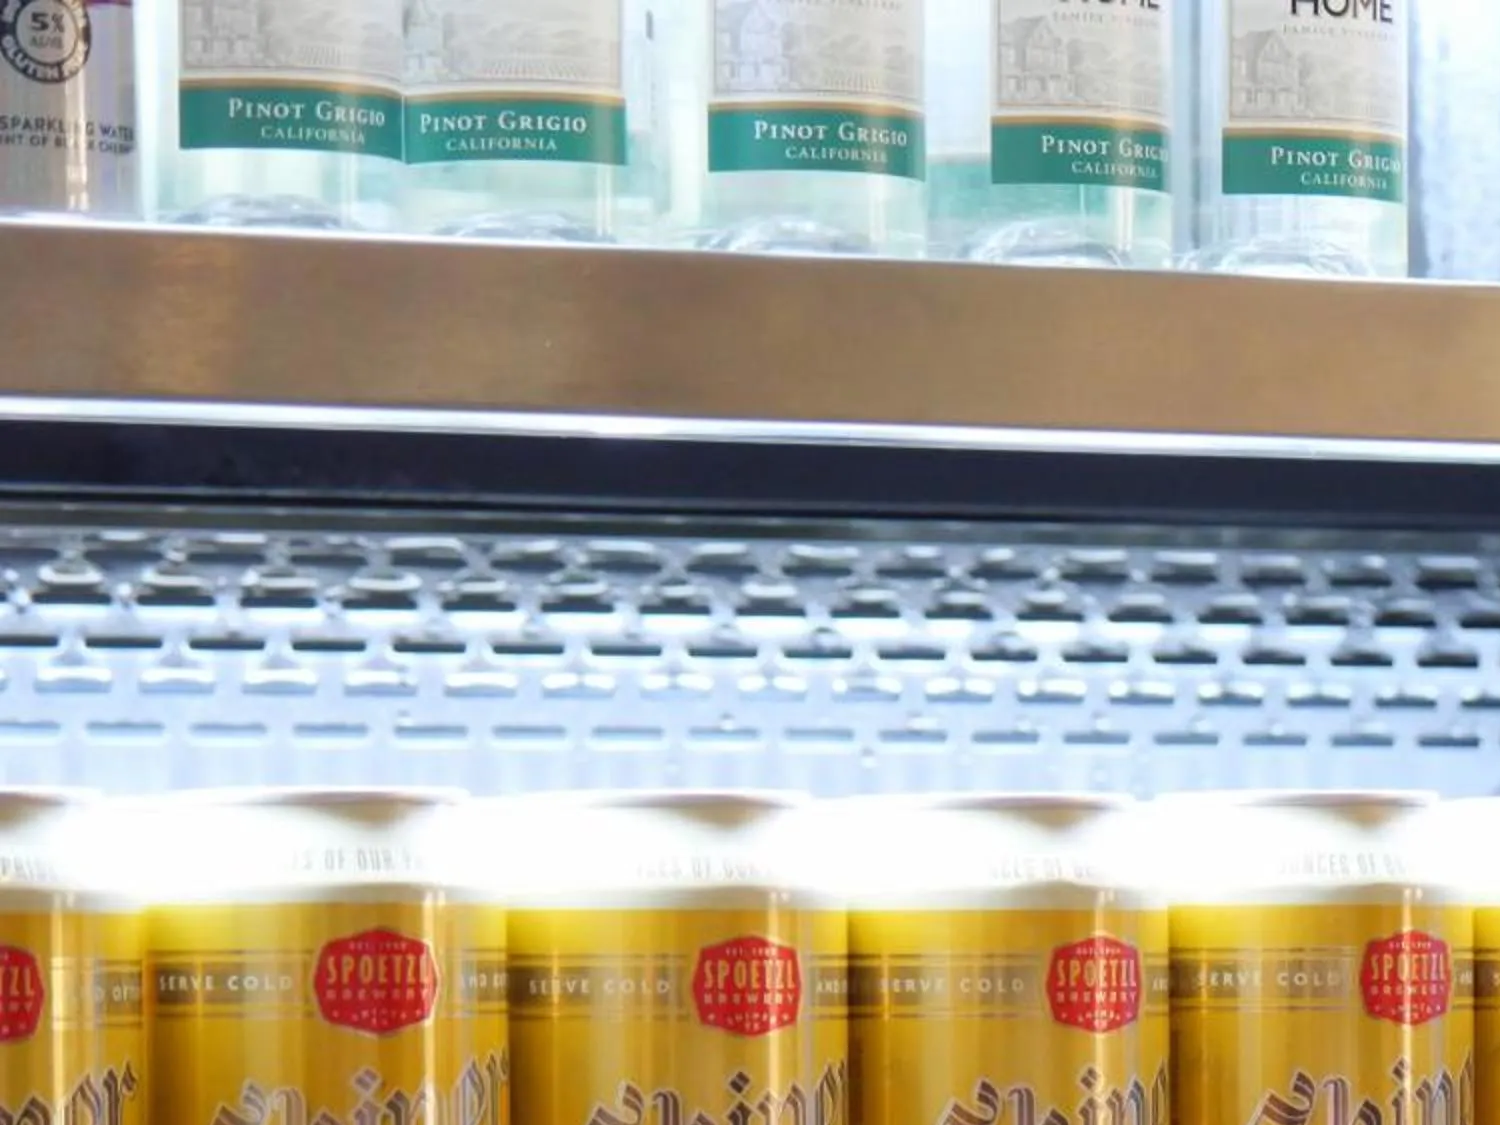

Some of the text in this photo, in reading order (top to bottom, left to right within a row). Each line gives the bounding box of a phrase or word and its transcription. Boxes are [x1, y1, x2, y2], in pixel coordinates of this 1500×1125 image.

[228, 98, 386, 127] PINOT GRIGIO
[419, 110, 588, 133] PINOT GRIGIO
[261, 125, 366, 144] CALIFORNIA
[446, 137, 558, 151] CALIFORNIA
[753, 120, 908, 147] PINOT GRIGIO
[1041, 134, 1111, 155] PINOT
[1270, 146, 1340, 166] PINOT
[326, 954, 432, 986] SPOETZL
[703, 959, 795, 989] SPOETZL
[1056, 958, 1137, 987] SPOETZL
[1370, 953, 1446, 981] SPOETZL
[158, 974, 293, 992] SERVE COLD
[529, 977, 672, 995] SERVE COLD
[880, 977, 1025, 993] SERVE COLD
[1197, 972, 1339, 987] SERVE COLD
